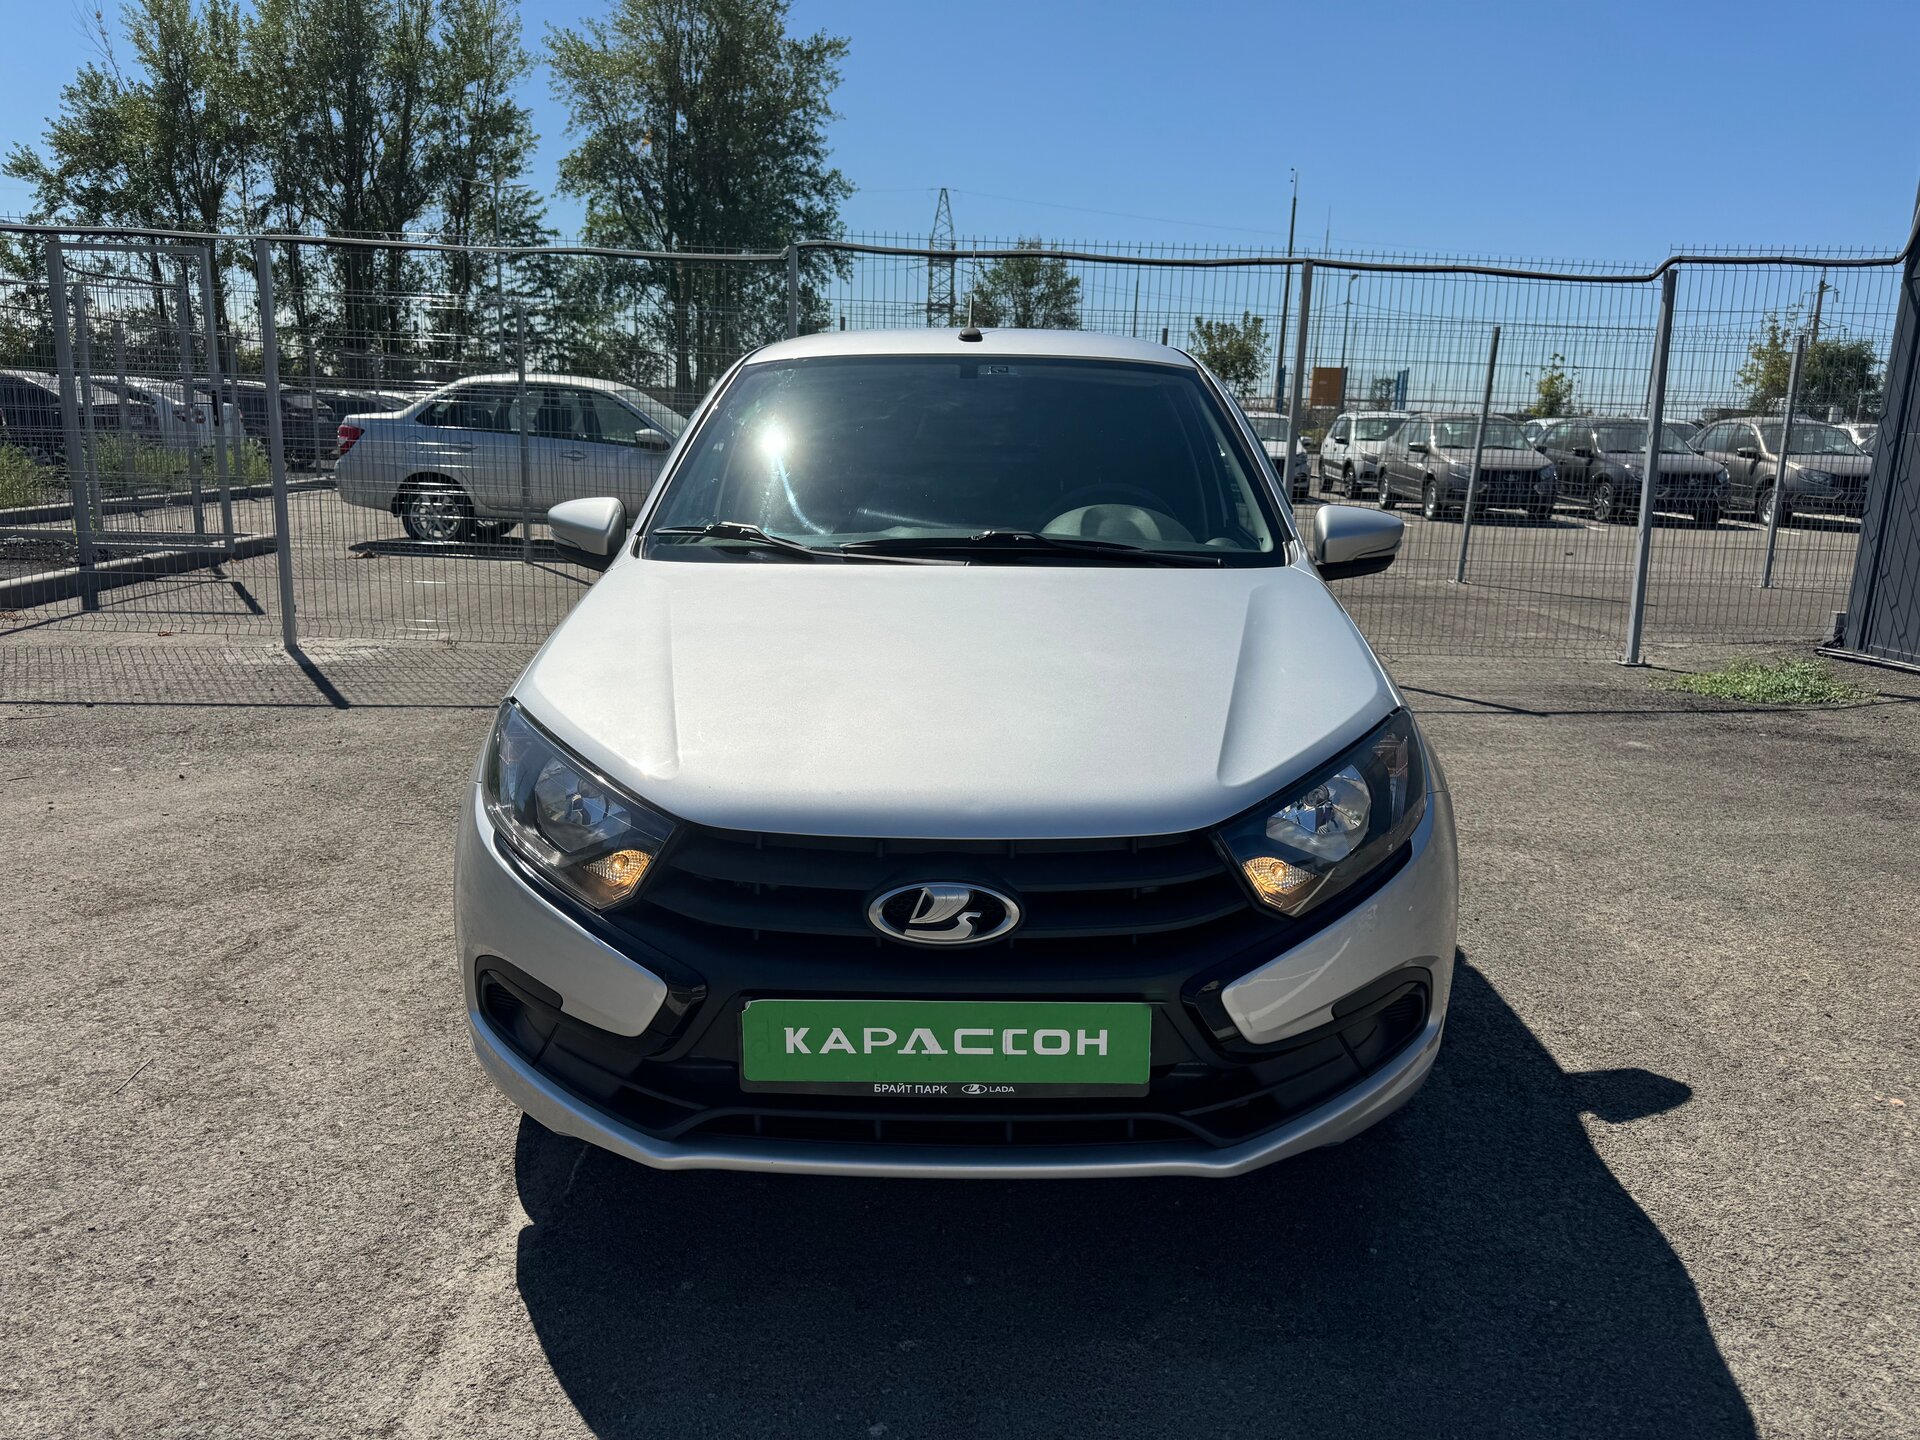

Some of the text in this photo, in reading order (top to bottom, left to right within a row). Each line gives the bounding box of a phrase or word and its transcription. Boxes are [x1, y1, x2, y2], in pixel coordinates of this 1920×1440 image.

[873, 1083, 948, 1095] БРАЙТ ПАРК
[989, 1085, 1015, 1093] LADA
